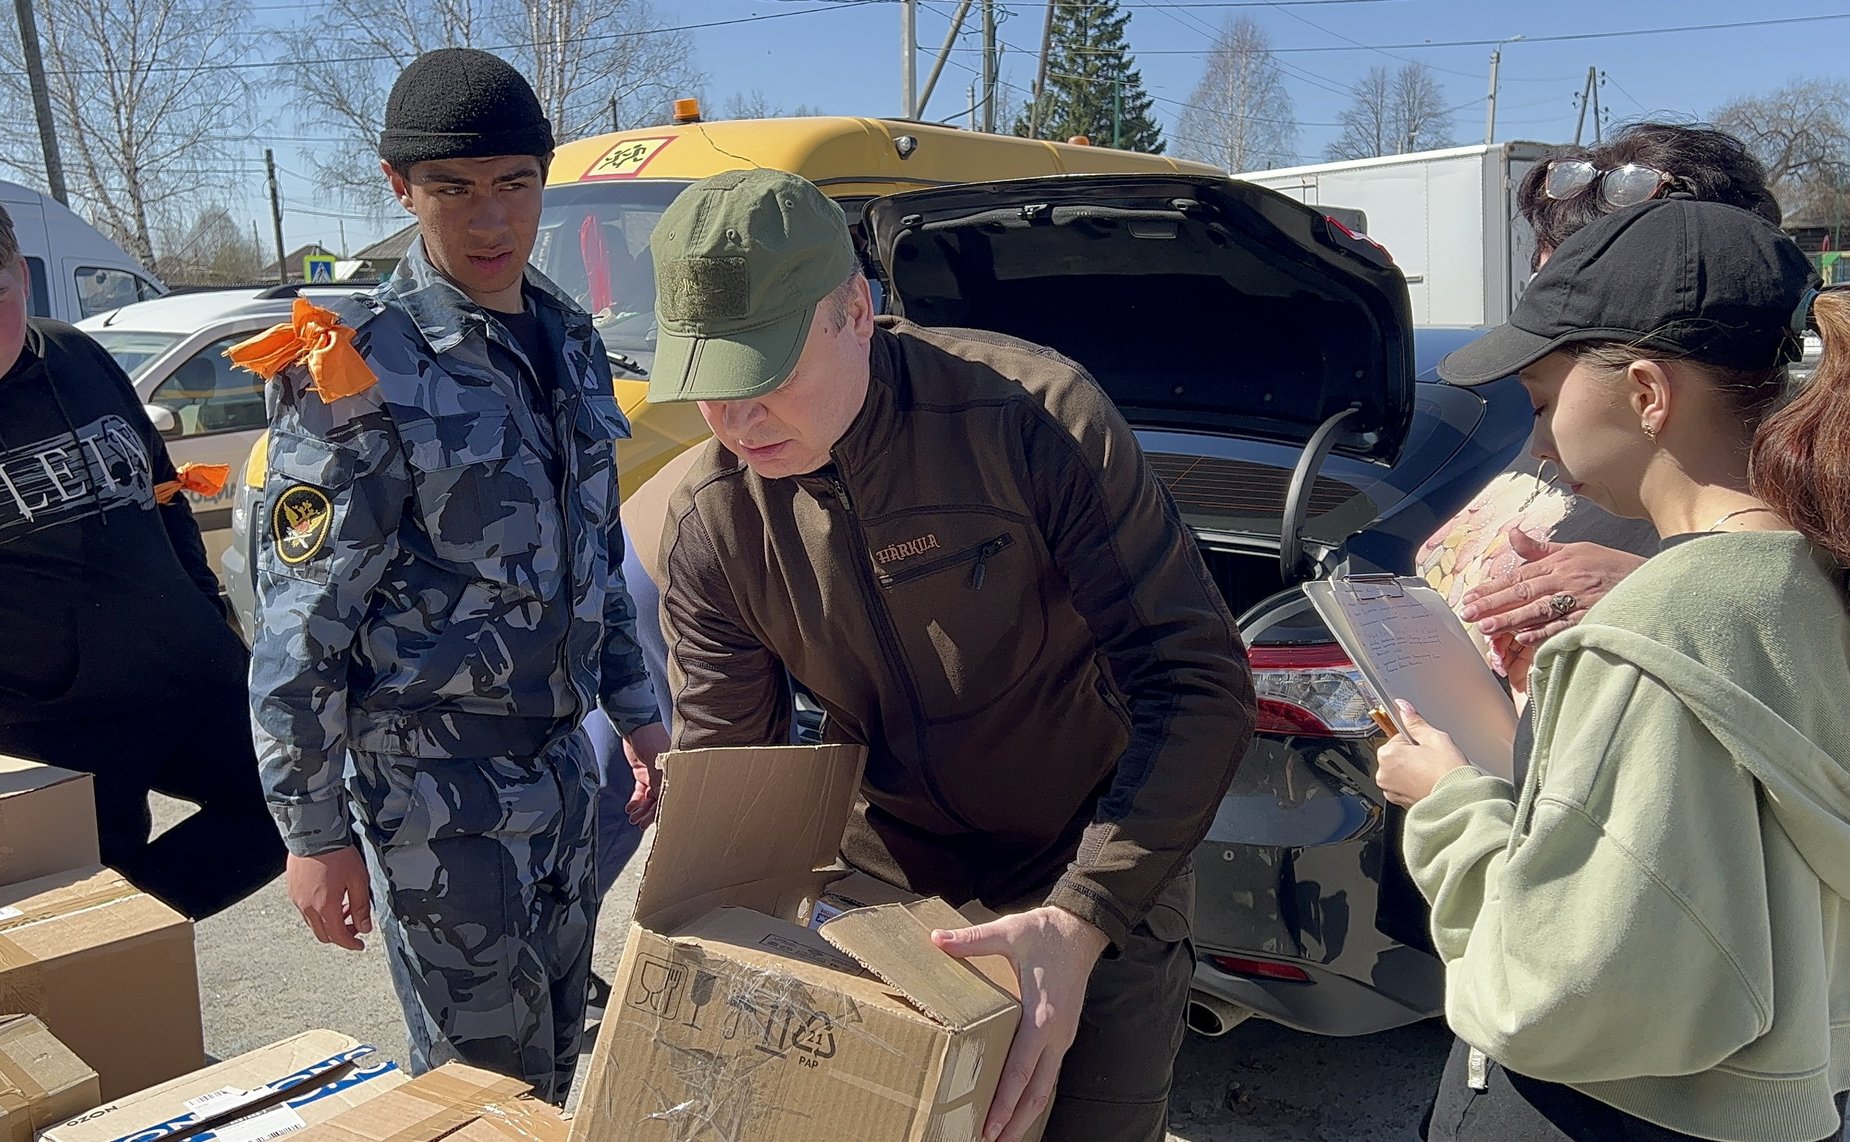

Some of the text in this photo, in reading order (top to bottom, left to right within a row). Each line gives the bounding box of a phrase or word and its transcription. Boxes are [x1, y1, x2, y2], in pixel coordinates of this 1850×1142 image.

[876, 533, 941, 565] HÄRKILA
[807, 1030, 823, 1046] 21
[799, 1055, 819, 1069] PAP
[66, 1105, 119, 1127] OZON
